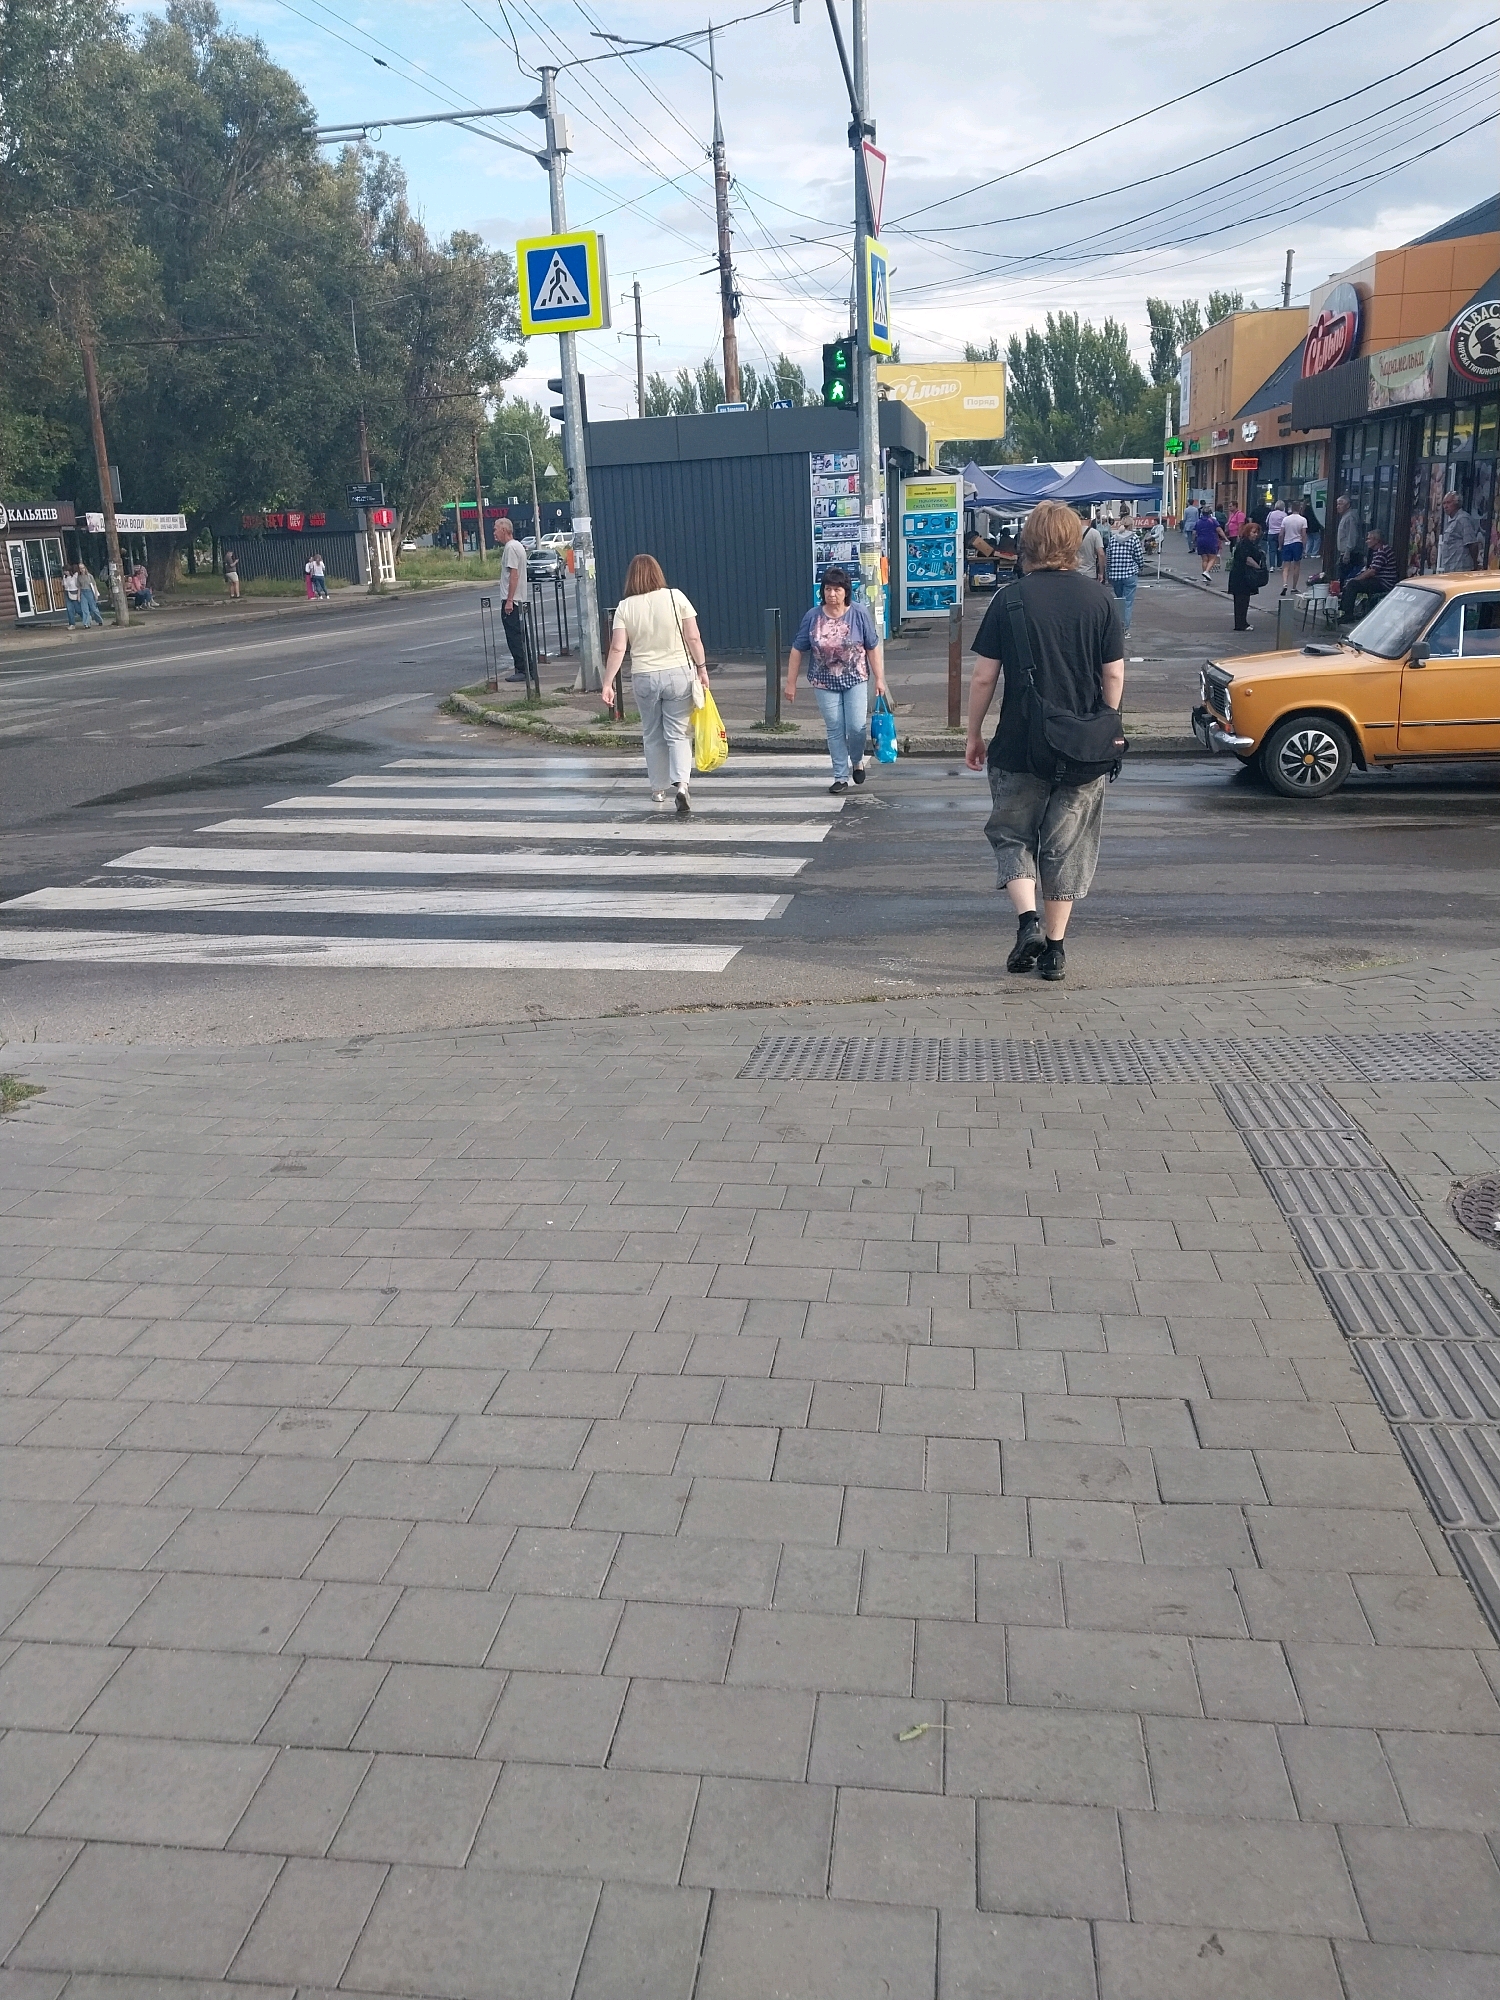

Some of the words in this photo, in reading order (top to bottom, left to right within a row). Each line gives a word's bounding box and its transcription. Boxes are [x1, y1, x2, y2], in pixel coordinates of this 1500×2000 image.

[1457, 303, 1500, 336] TABAC
[1378, 350, 1424, 378] Карамелька
[887, 380, 958, 402] Сільпо
[967, 398, 995, 407] Поряд
[7, 508, 58, 521] КАЛЬЯНІВ
